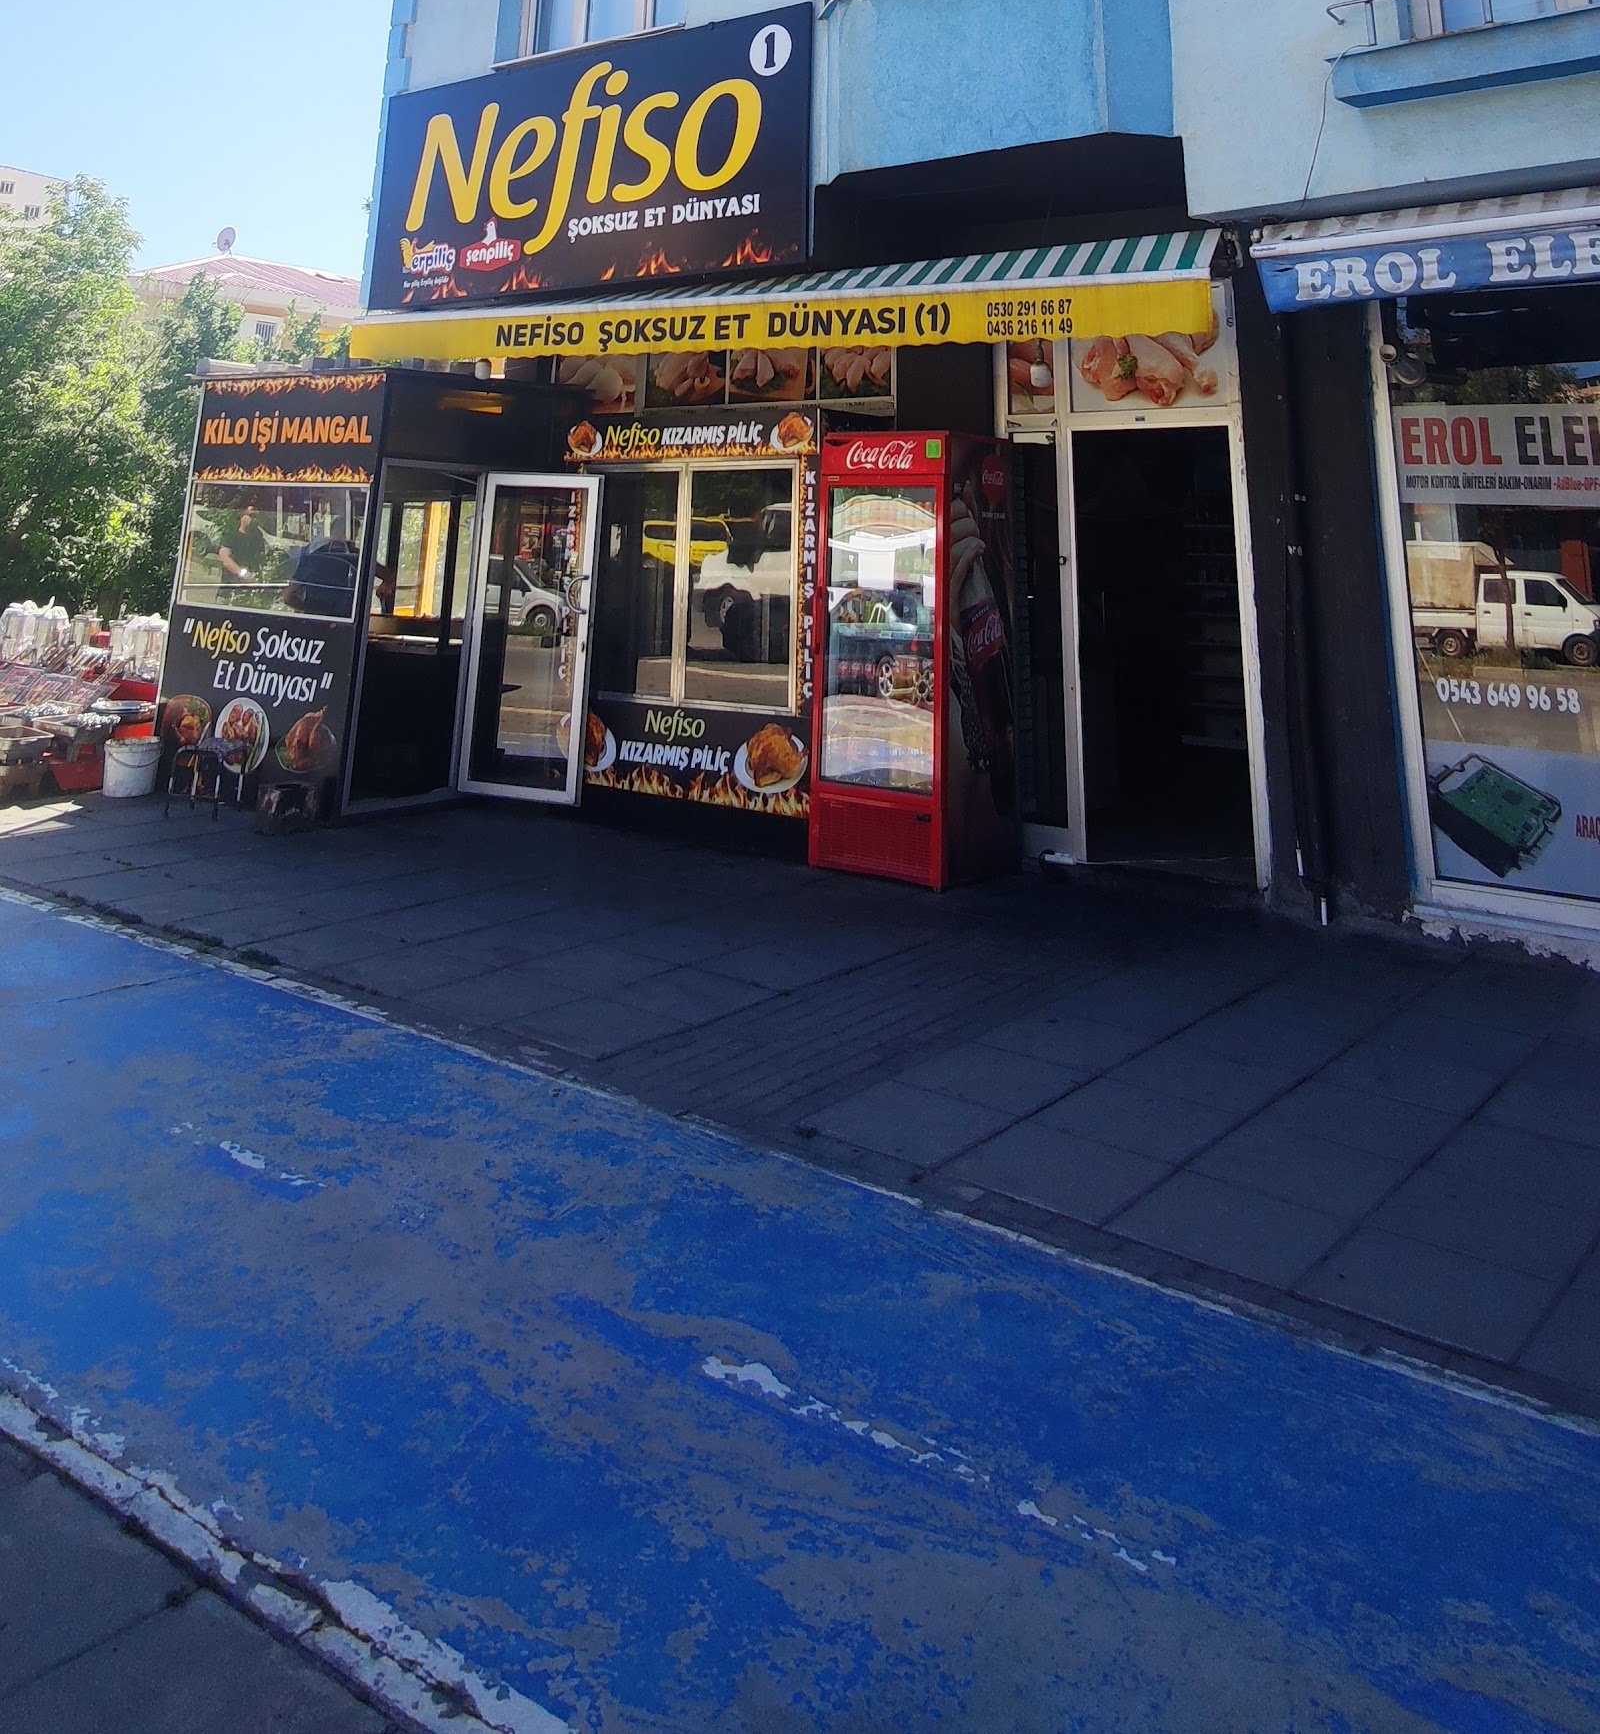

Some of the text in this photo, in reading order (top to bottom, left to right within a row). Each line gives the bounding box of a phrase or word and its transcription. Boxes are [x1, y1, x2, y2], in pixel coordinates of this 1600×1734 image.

[763, 31, 778, 69] 1
[405, 61, 763, 256] Nefiso
[567, 193, 761, 244] ŞOKSUZ ET DÜNYASI
[1294, 248, 1457, 301] EROL
[495, 301, 951, 353] NEFİSO ŞOKSUZ ET DÜNYASI (1)
[986, 298, 1073, 318] 0530 291 66 87
[986, 317, 1073, 337] 0436 216 11 49
[203, 409, 373, 453] KİLO İŞİ MANGAL
[604, 420, 764, 455] Nefiso KIZARMIŞ PİLİÇ
[1400, 416, 1503, 465] EROL
[1405, 474, 1429, 489] MOTOR
[1430, 474, 1461, 489] KONTROL
[1462, 472, 1497, 490] ÜNİTELERİ
[803, 470, 817, 599] KIZARMIŞ
[252, 626, 326, 665] Şoksuz
[802, 615, 814, 699] PİLİÇ
[212, 659, 236, 691] Et
[1435, 677, 1582, 715] 0543 649 96 58
[643, 708, 706, 743] Nefiso
[619, 739, 732, 777] KIZARMIŞ PİLİÇ
